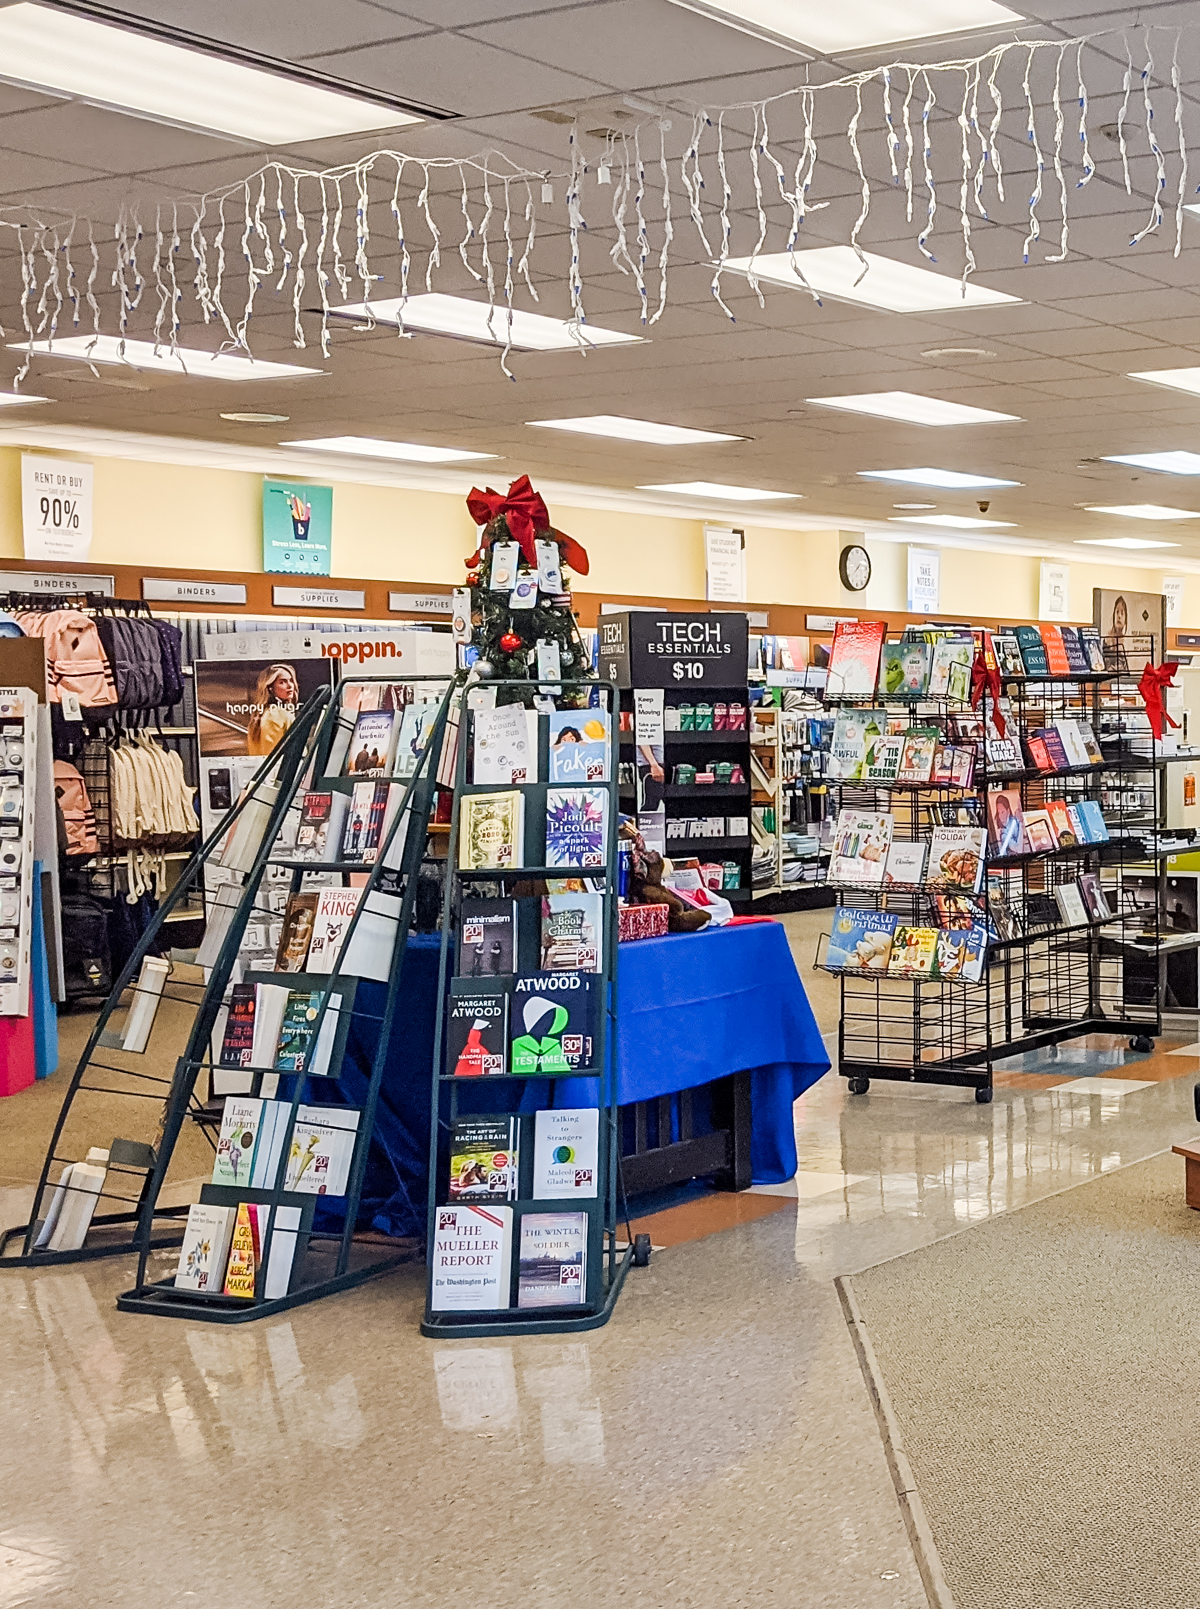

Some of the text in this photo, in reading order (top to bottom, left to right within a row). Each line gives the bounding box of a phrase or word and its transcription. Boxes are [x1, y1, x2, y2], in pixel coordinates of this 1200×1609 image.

[34, 471, 83, 488] RENT OR BUY
[40, 496, 80, 529] 90%
[919, 566, 932, 576] TAKE
[33, 579, 78, 589] BINDERS
[916, 576, 931, 587] NOTES
[177, 586, 216, 597] BINDERS
[300, 593, 339, 604] SUPPLIES
[414, 599, 449, 609] SUPPLIES
[602, 622, 622, 644] TECH
[656, 621, 722, 643] TECH
[321, 639, 403, 665] oppin.
[600, 643, 625, 654] ESSENTIALS
[648, 642, 732, 654] ESSENTIALS
[609, 662, 618, 680] $5
[672, 661, 704, 681] $10
[637, 696, 654, 705] Keep
[226, 701, 265, 717] happy
[637, 708, 661, 718] Moving
[492, 713, 512, 722] Once
[487, 720, 517, 732] Around
[486, 728, 520, 740] the Sun
[990, 738, 1015, 752] STAR
[990, 749, 1016, 762] WARS
[562, 811, 587, 822] Jodi
[639, 817, 652, 826] Stay
[550, 820, 602, 834] Picoult
[639, 823, 664, 831] powered
[934, 833, 968, 841] HOLIDAY
[324, 890, 358, 901] STEPHEN
[320, 900, 356, 917] KING
[466, 913, 511, 924] minimalism
[839, 908, 858, 918] God
[857, 909, 880, 922] Gave
[558, 916, 582, 927] Book
[842, 918, 893, 932] Christmas
[515, 976, 581, 993] ATWOOD
[294, 1003, 308, 1011] Little
[457, 999, 497, 1008] MARGARET
[452, 1006, 502, 1018] ATWOOD
[282, 1026, 314, 1036] Everywhere
[514, 1055, 581, 1066] TESTAMENTS
[231, 1104, 254, 1117] Liane
[223, 1117, 258, 1130] Moriarty
[551, 1115, 580, 1123] Talking
[296, 1126, 334, 1137] Kingsolver
[455, 1133, 508, 1142] RACING RAIN
[546, 1134, 583, 1142] Strangers
[455, 1226, 483, 1236] THE
[525, 1227, 581, 1237] THE WINTER
[436, 1240, 499, 1251] MUELLER
[532, 1240, 571, 1249] SOLDIER
[440, 1255, 494, 1266] REPORT
[435, 1277, 498, 1287] The Washington Post
